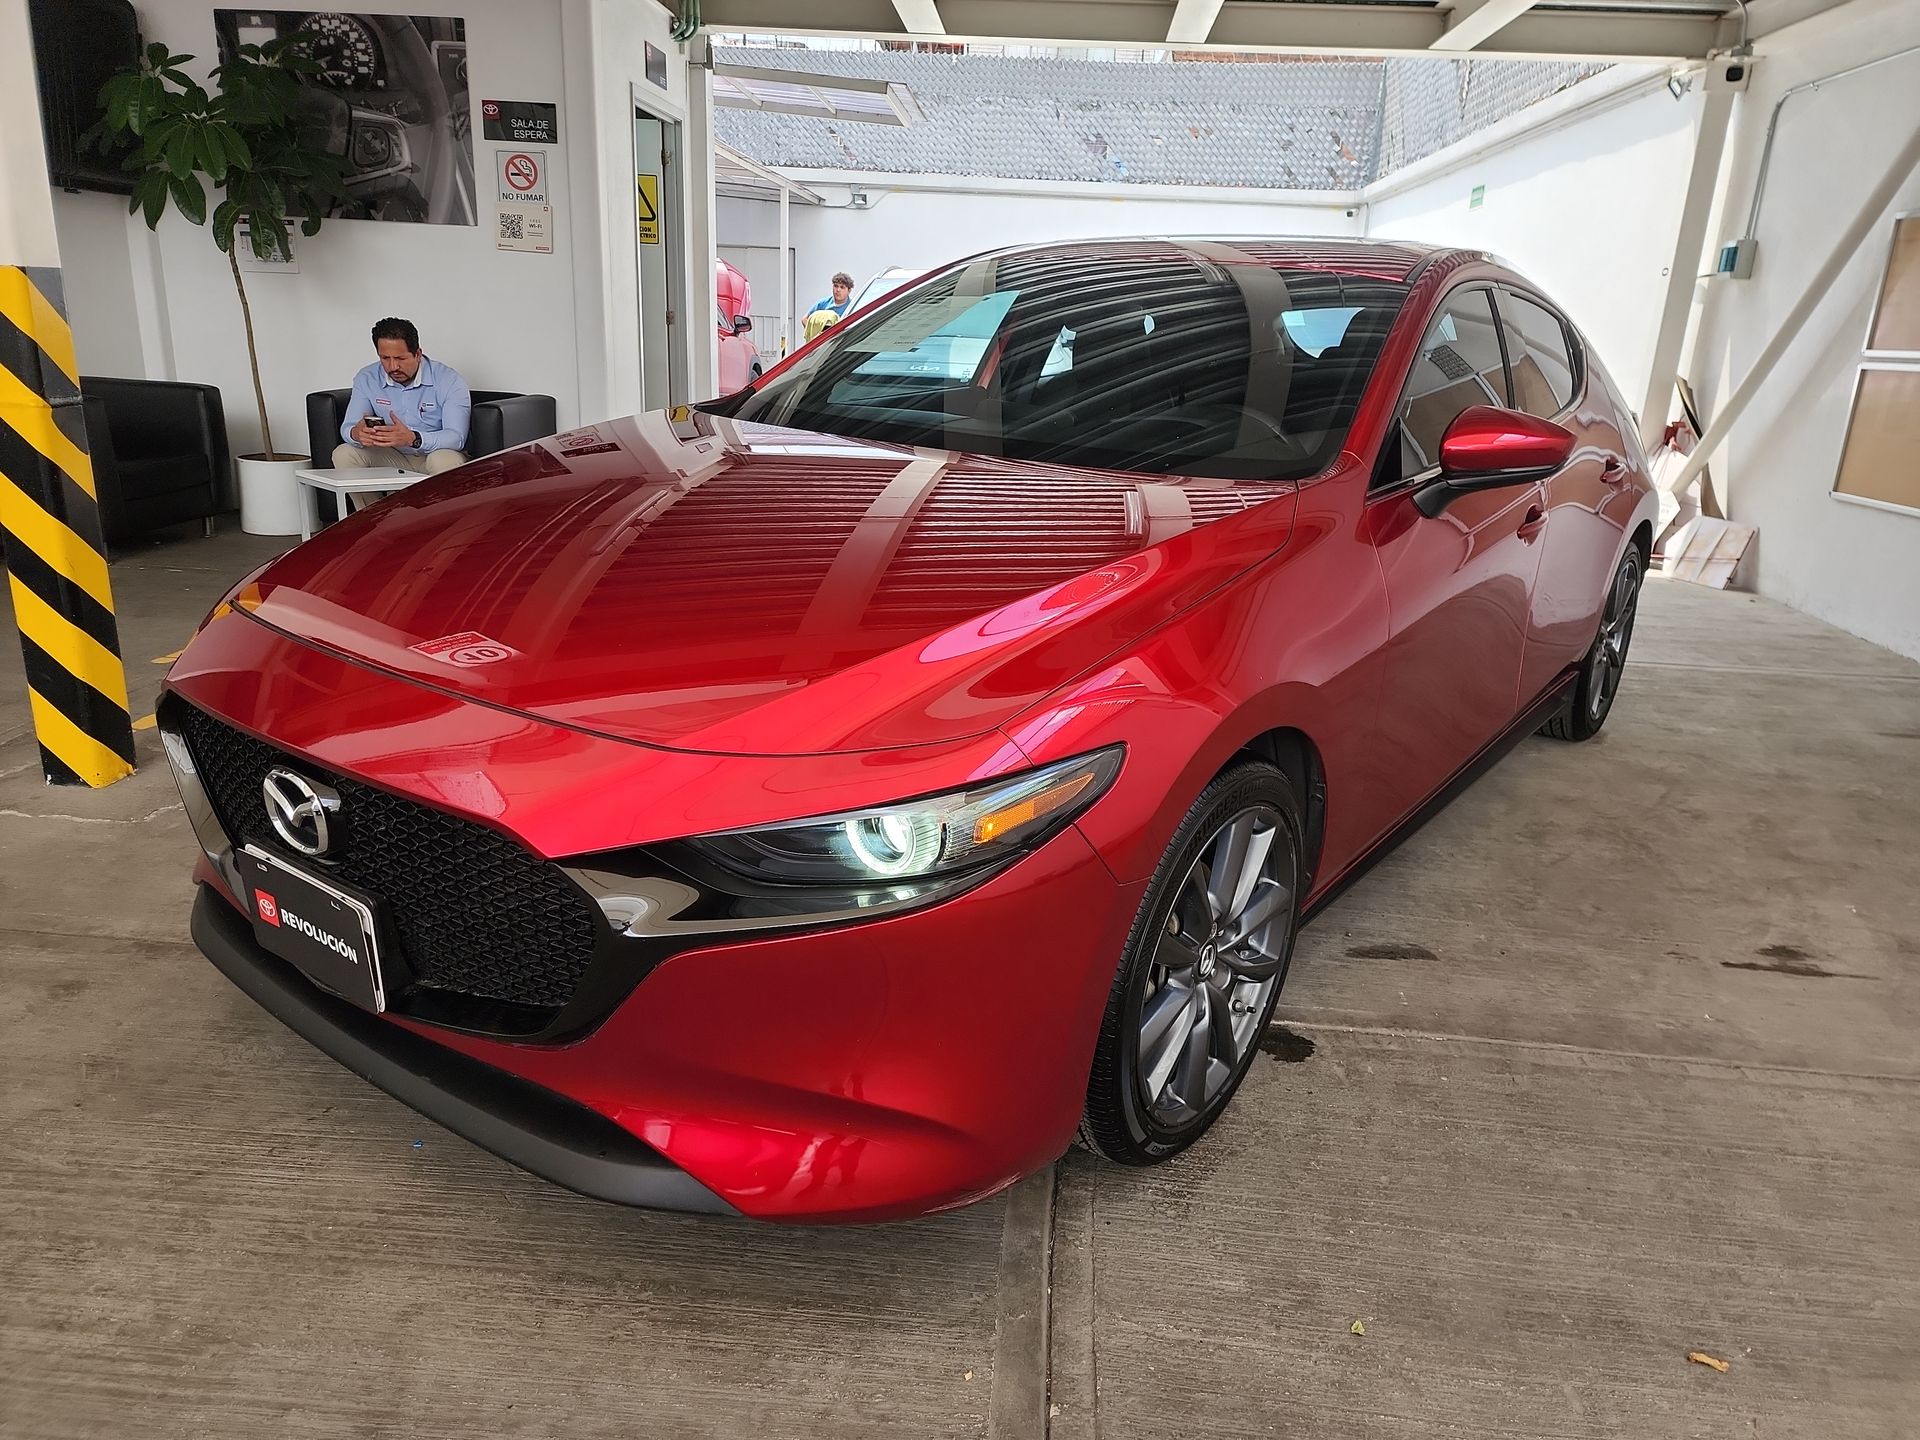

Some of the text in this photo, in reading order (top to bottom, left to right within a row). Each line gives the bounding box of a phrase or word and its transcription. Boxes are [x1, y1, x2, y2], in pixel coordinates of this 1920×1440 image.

[511, 118, 549, 129] SALA DE
[514, 129, 548, 140] ESPERA
[502, 192, 544, 201] NO FUMAR
[280, 908, 358, 965] REVOLUCIÓN
